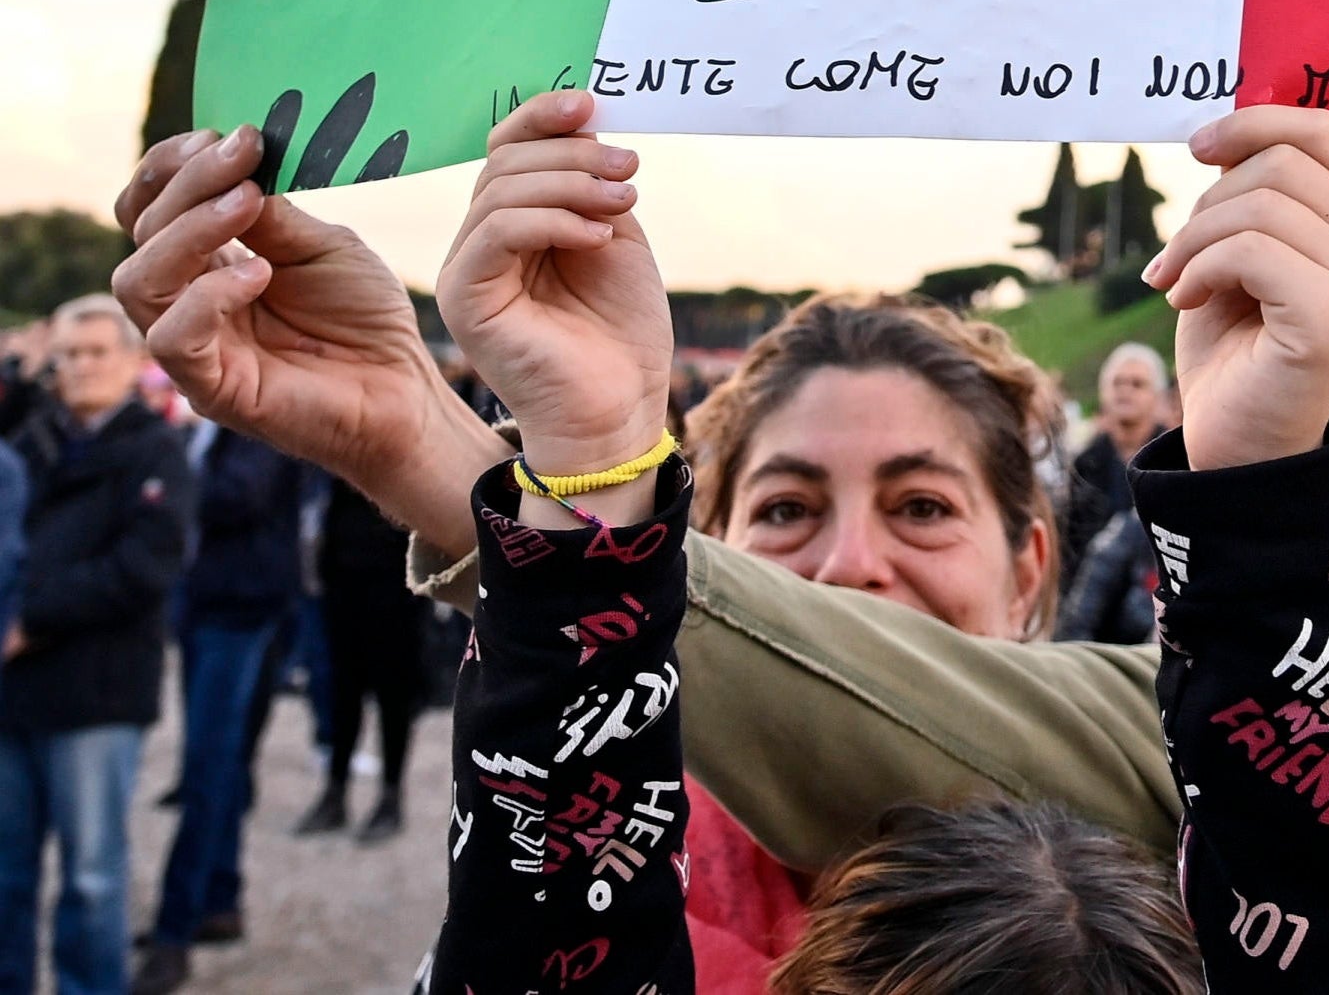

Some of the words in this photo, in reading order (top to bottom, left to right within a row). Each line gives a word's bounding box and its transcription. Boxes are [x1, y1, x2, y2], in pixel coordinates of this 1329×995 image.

[785, 51, 945, 101] COME
[1000, 57, 1099, 99] NOI
[1144, 54, 1245, 101] NON
[587, 780, 681, 912] HELLO
